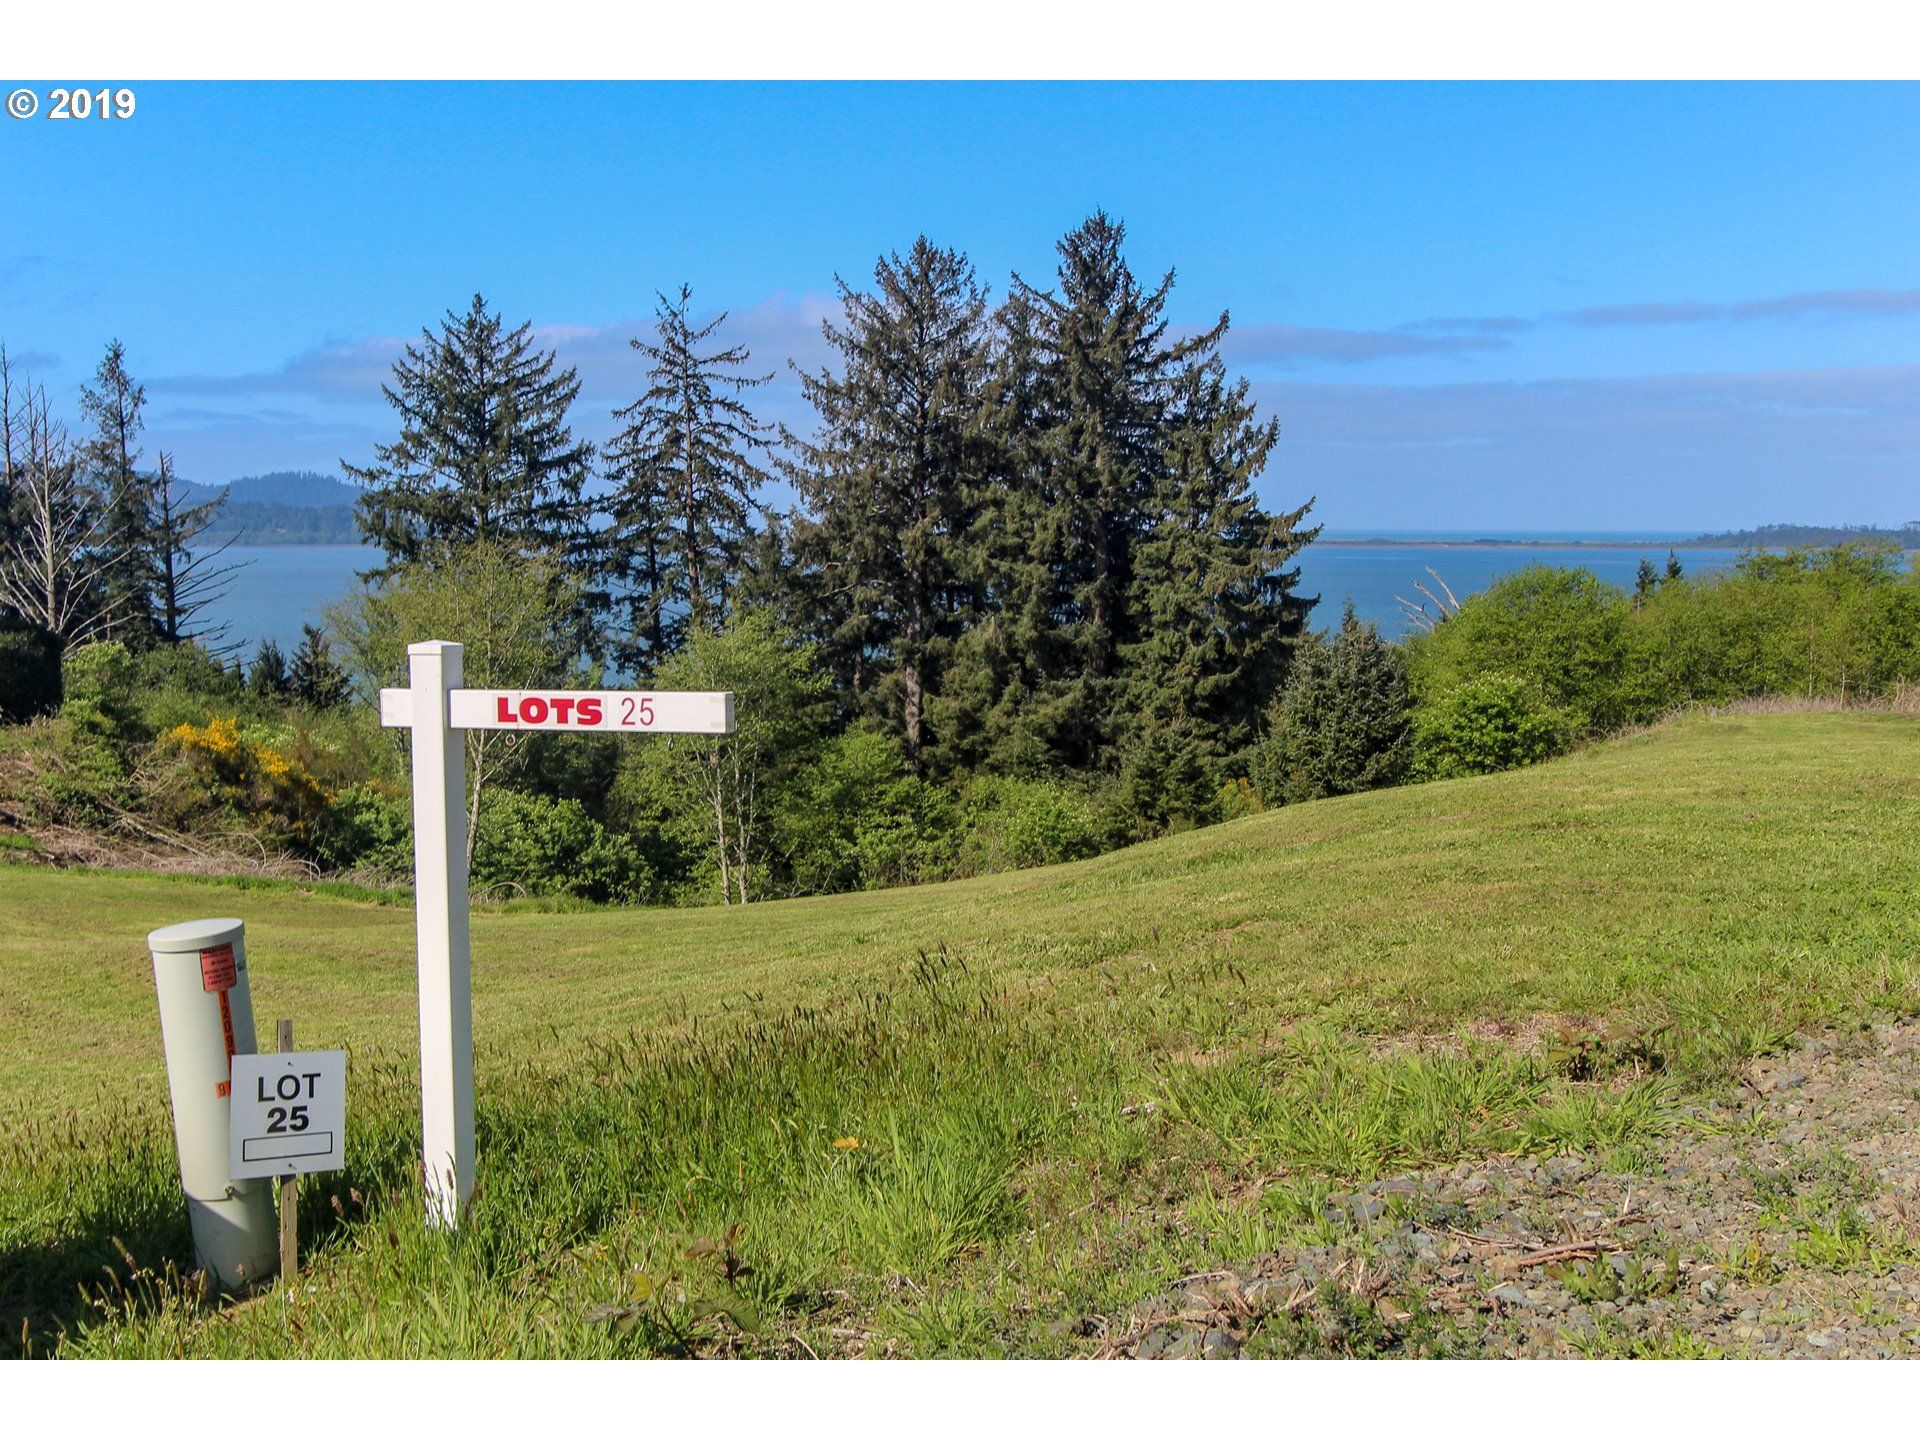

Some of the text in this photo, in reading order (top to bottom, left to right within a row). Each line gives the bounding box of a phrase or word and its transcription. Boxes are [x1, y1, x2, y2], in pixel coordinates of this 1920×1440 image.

[497, 697, 655, 726] LOTS 25
[258, 1073, 322, 1103] LOT
[267, 1106, 309, 1133] 25
